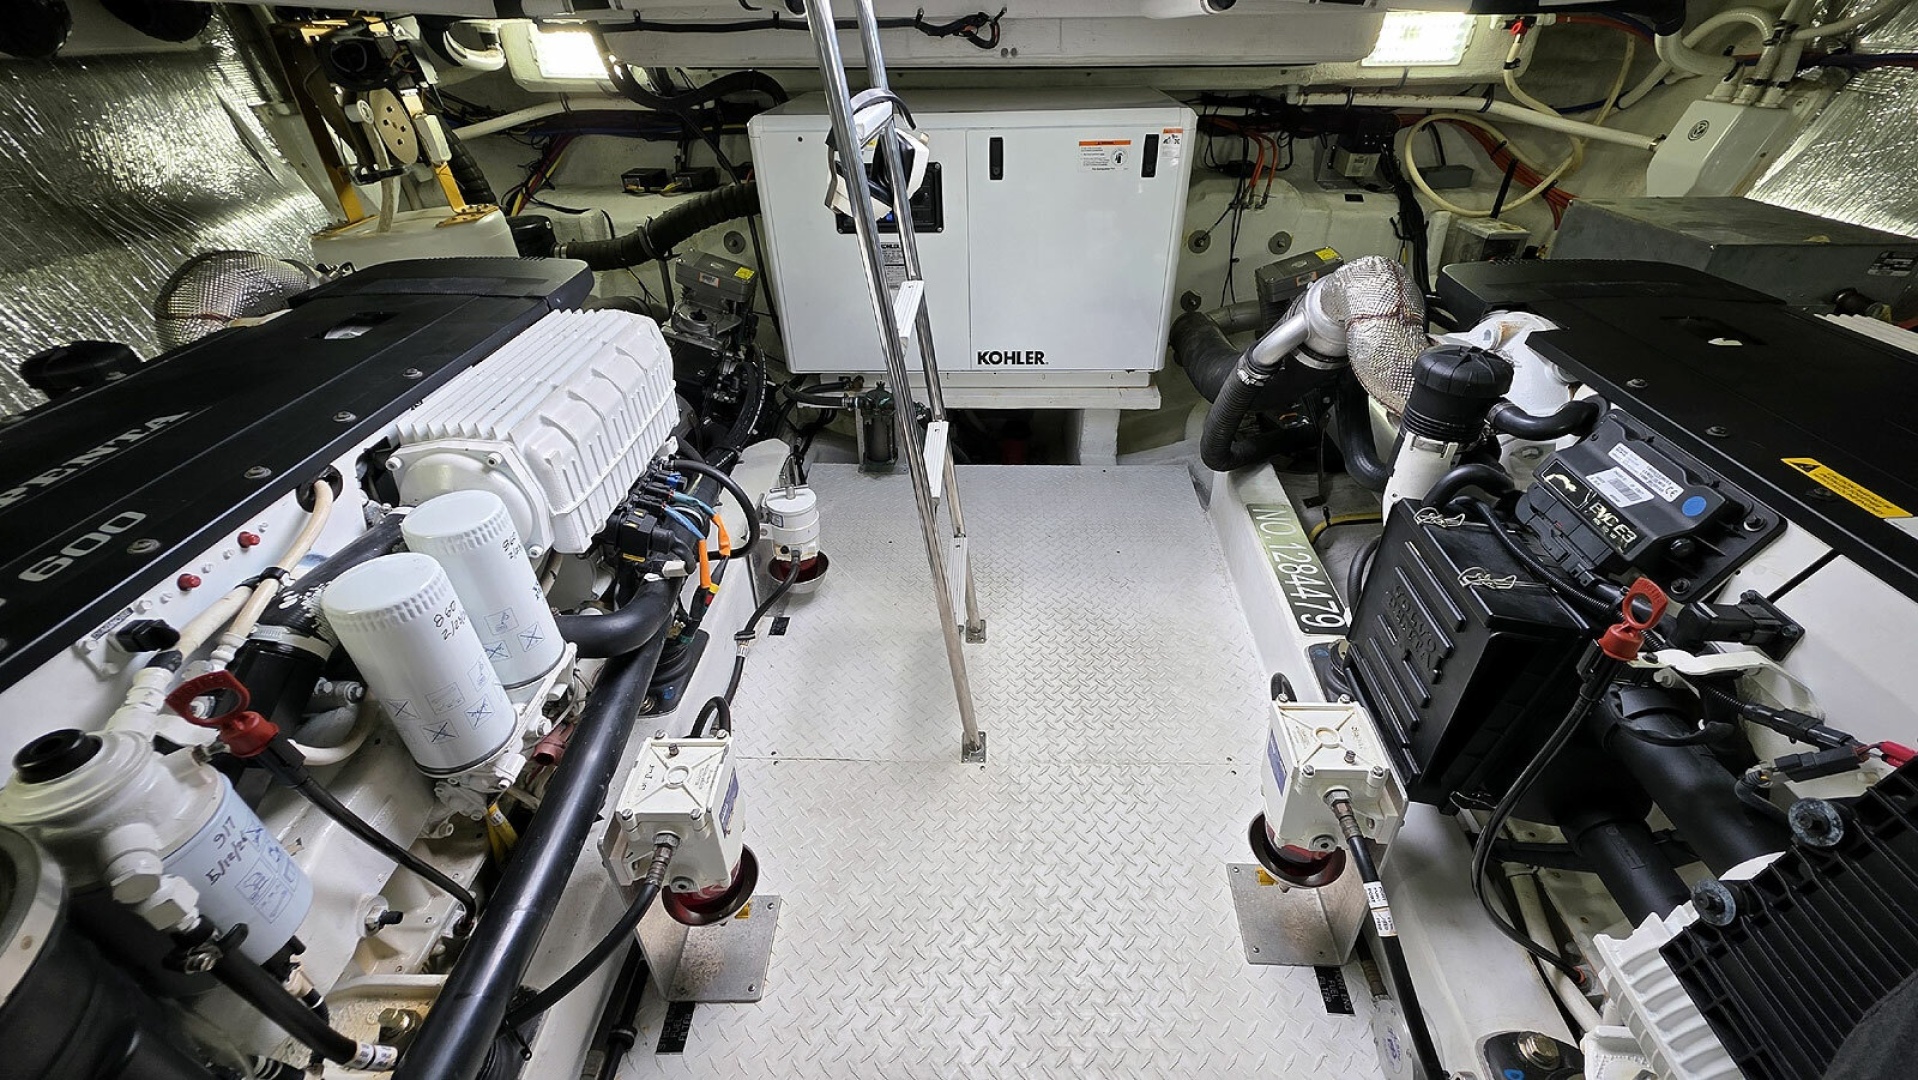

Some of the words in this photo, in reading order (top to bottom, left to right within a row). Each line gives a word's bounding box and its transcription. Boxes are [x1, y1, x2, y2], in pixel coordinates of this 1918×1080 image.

[977, 350, 1049, 365] KOHLER
[0, 412, 190, 507] PENTA
[18, 512, 147, 582] 600
